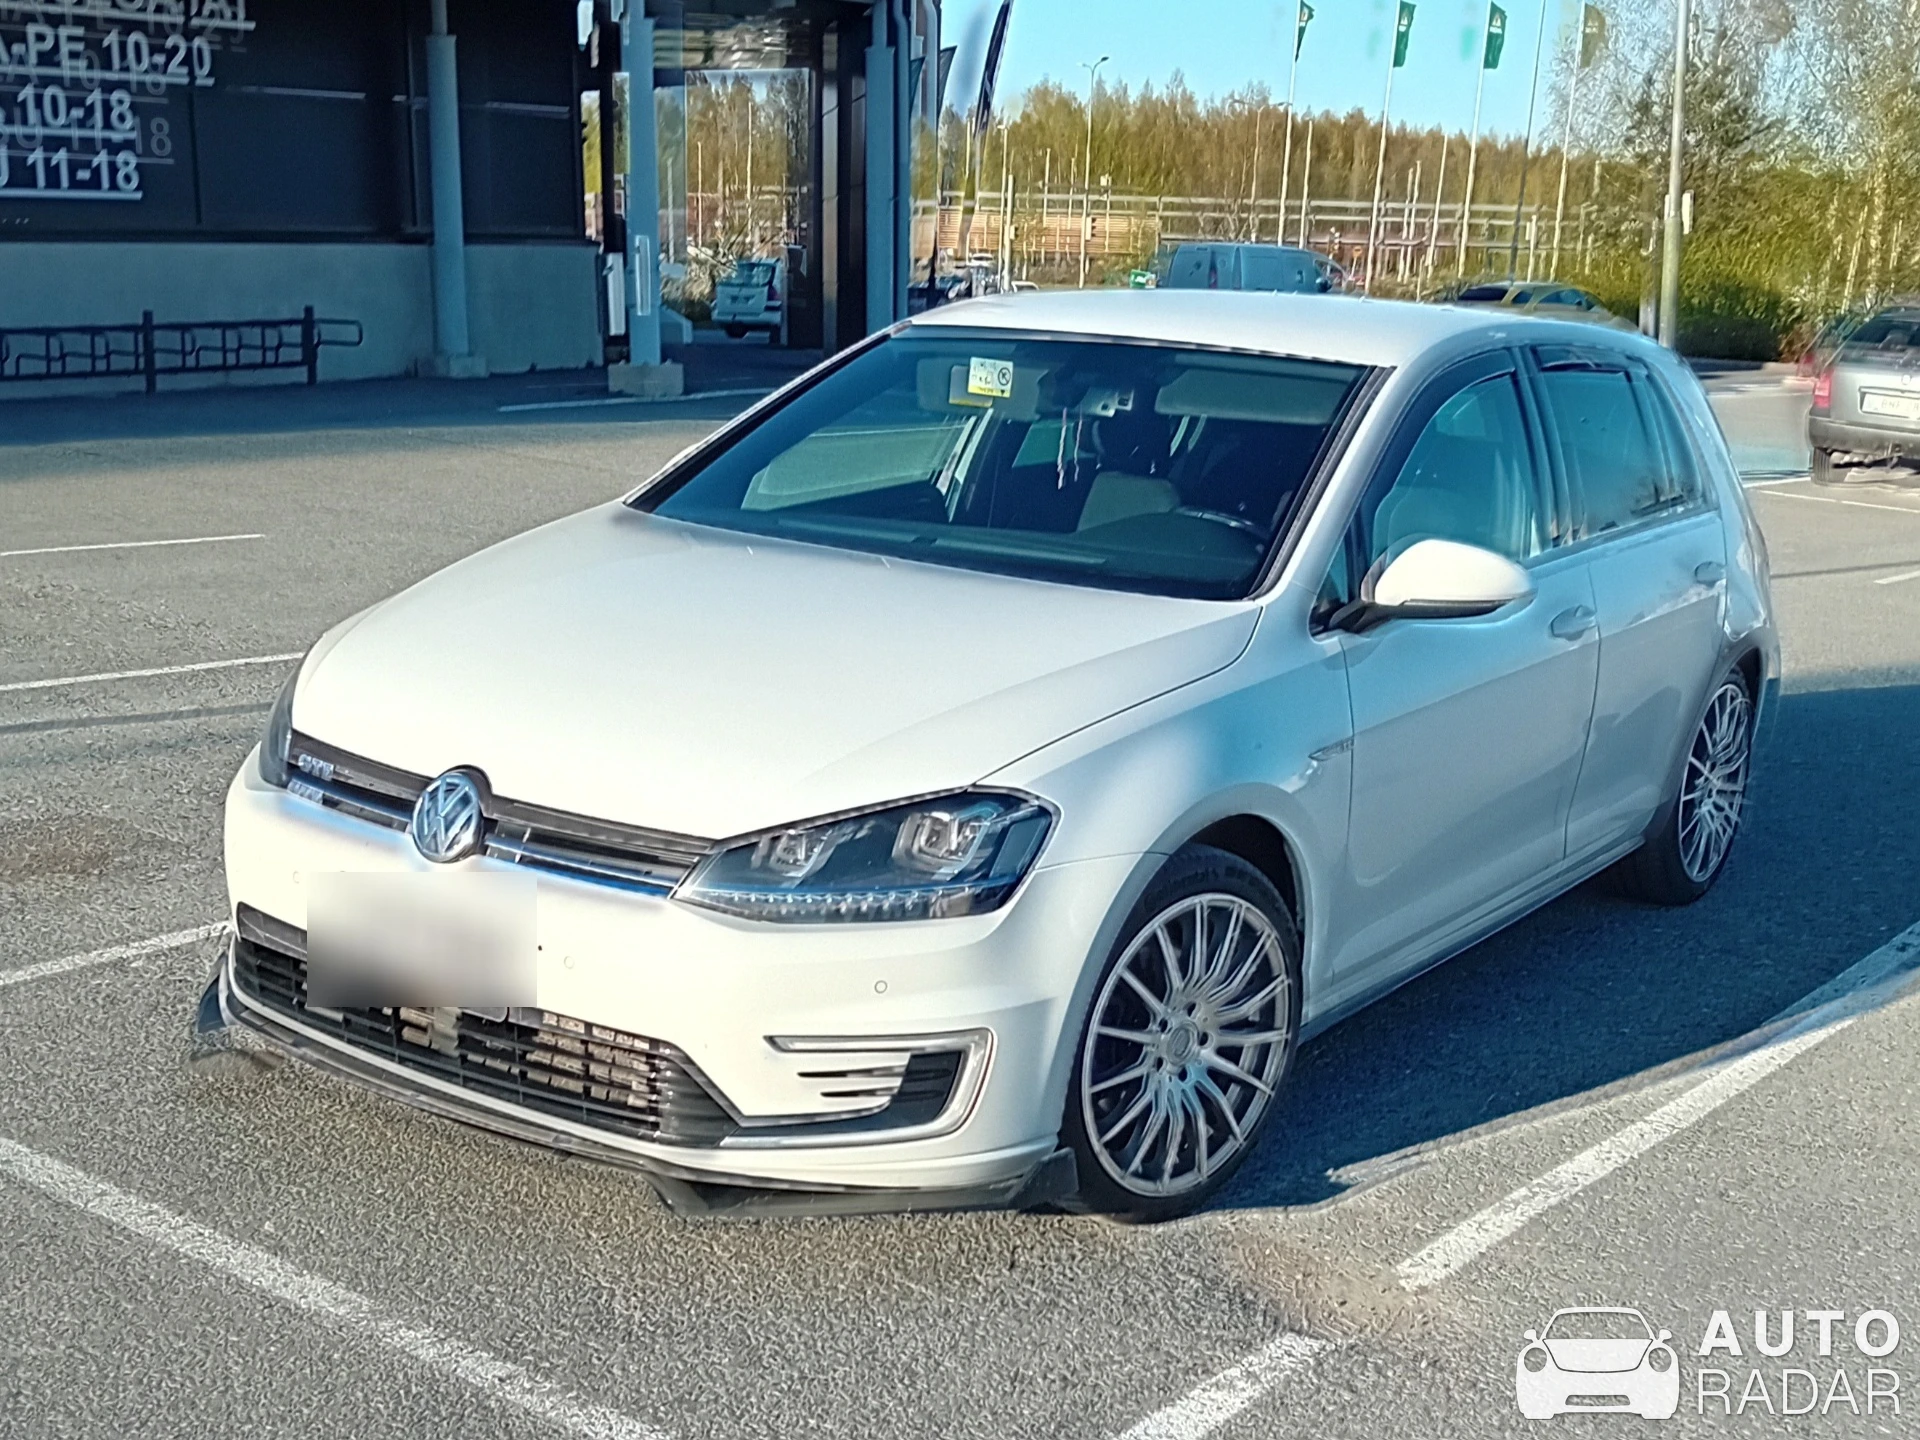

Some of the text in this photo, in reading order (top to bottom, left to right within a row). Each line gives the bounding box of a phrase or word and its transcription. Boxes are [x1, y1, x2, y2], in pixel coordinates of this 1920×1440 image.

[0, 22, 213, 77] -PE 10-20
[17, 83, 134, 130] 10-18
[27, 146, 140, 191] 11-18
[297, 753, 334, 782] GTE
